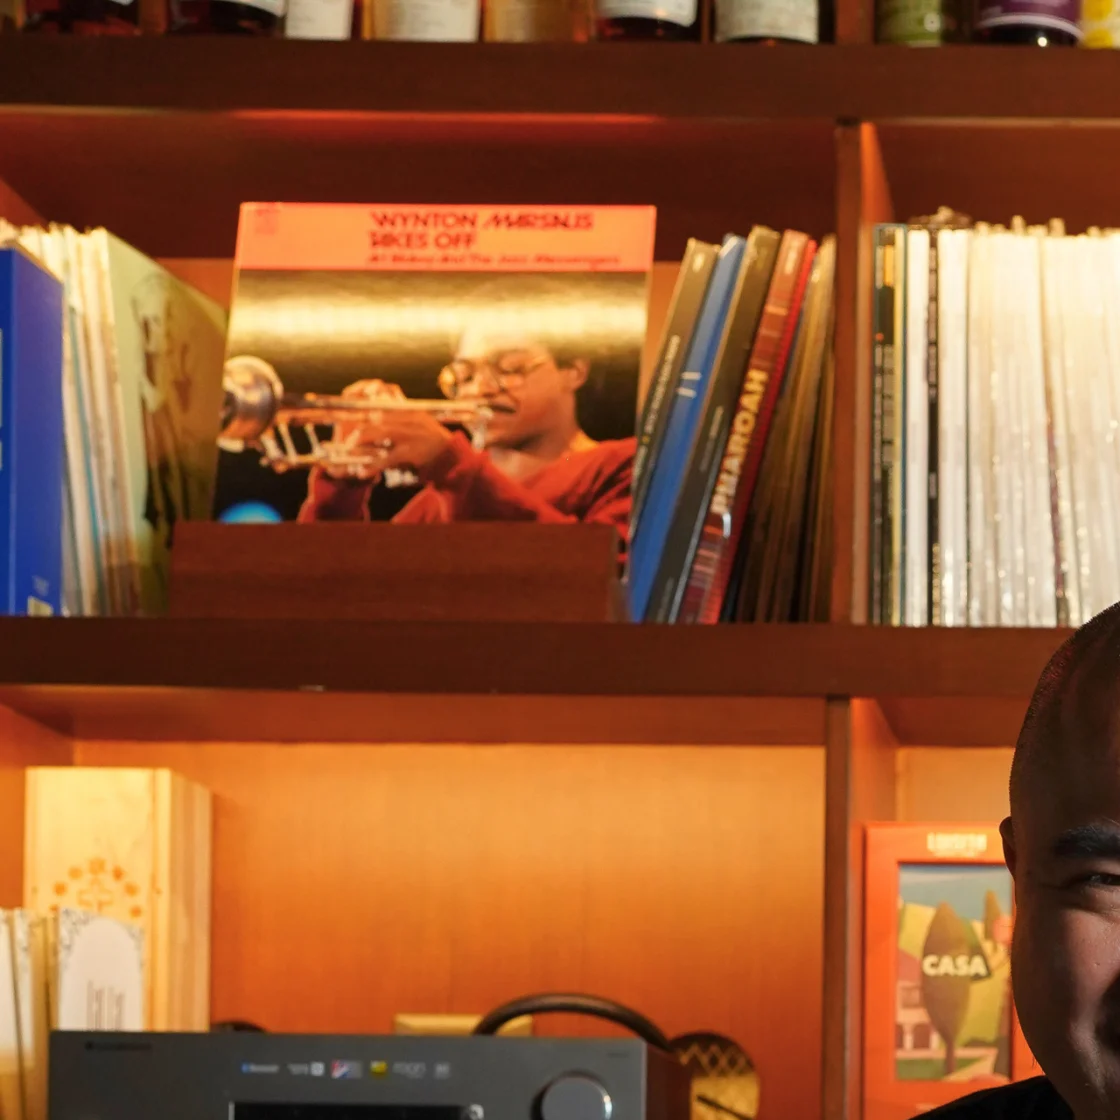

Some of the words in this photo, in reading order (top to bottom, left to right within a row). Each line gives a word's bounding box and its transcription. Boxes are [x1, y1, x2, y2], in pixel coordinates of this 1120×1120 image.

[369, 211, 478, 229] WYNTON
[434, 231, 477, 249] OFF
[710, 366, 770, 514] PHAROAH
[921, 954, 988, 978] CASA
